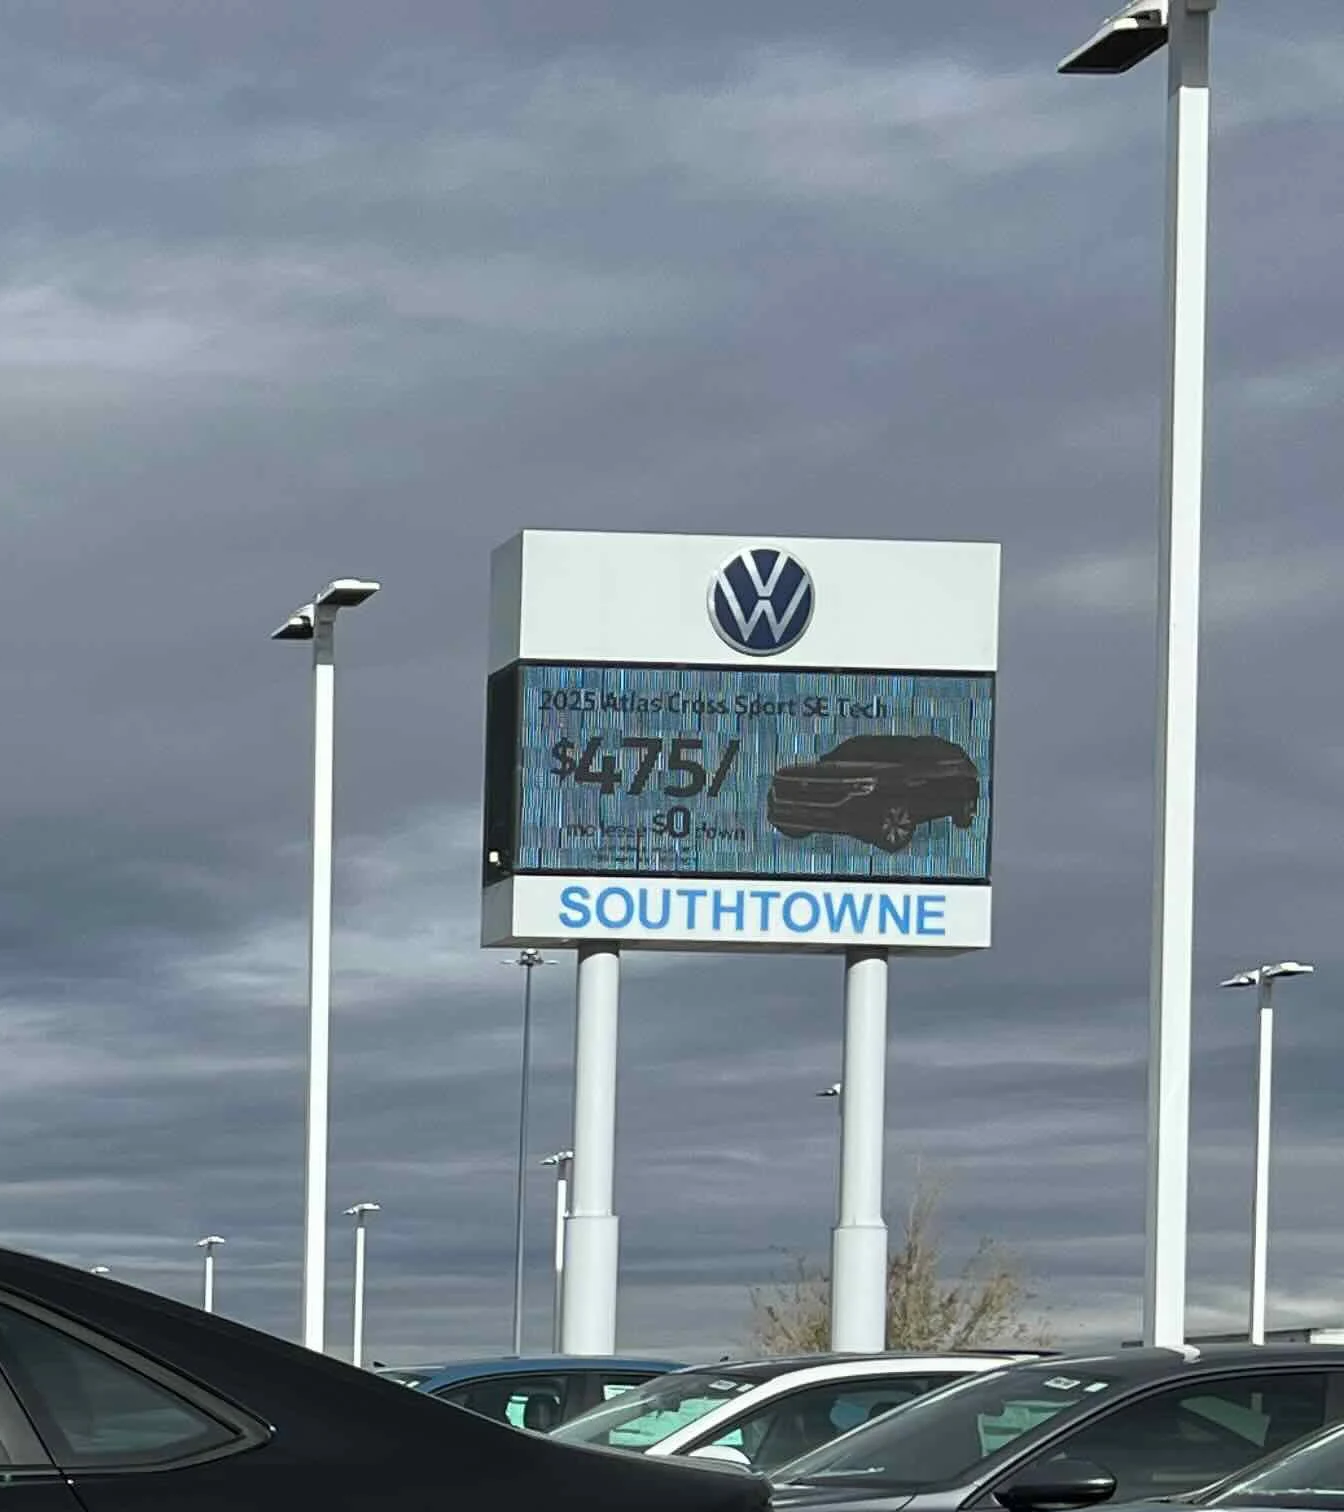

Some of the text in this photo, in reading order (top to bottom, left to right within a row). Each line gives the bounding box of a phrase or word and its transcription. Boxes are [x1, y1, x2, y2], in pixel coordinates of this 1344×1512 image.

[708, 546, 815, 656] VW
[539, 689, 888, 720] 2025 Atlas Cross Sport SE Tech
[558, 886, 946, 936] SOUTHTOWNE
